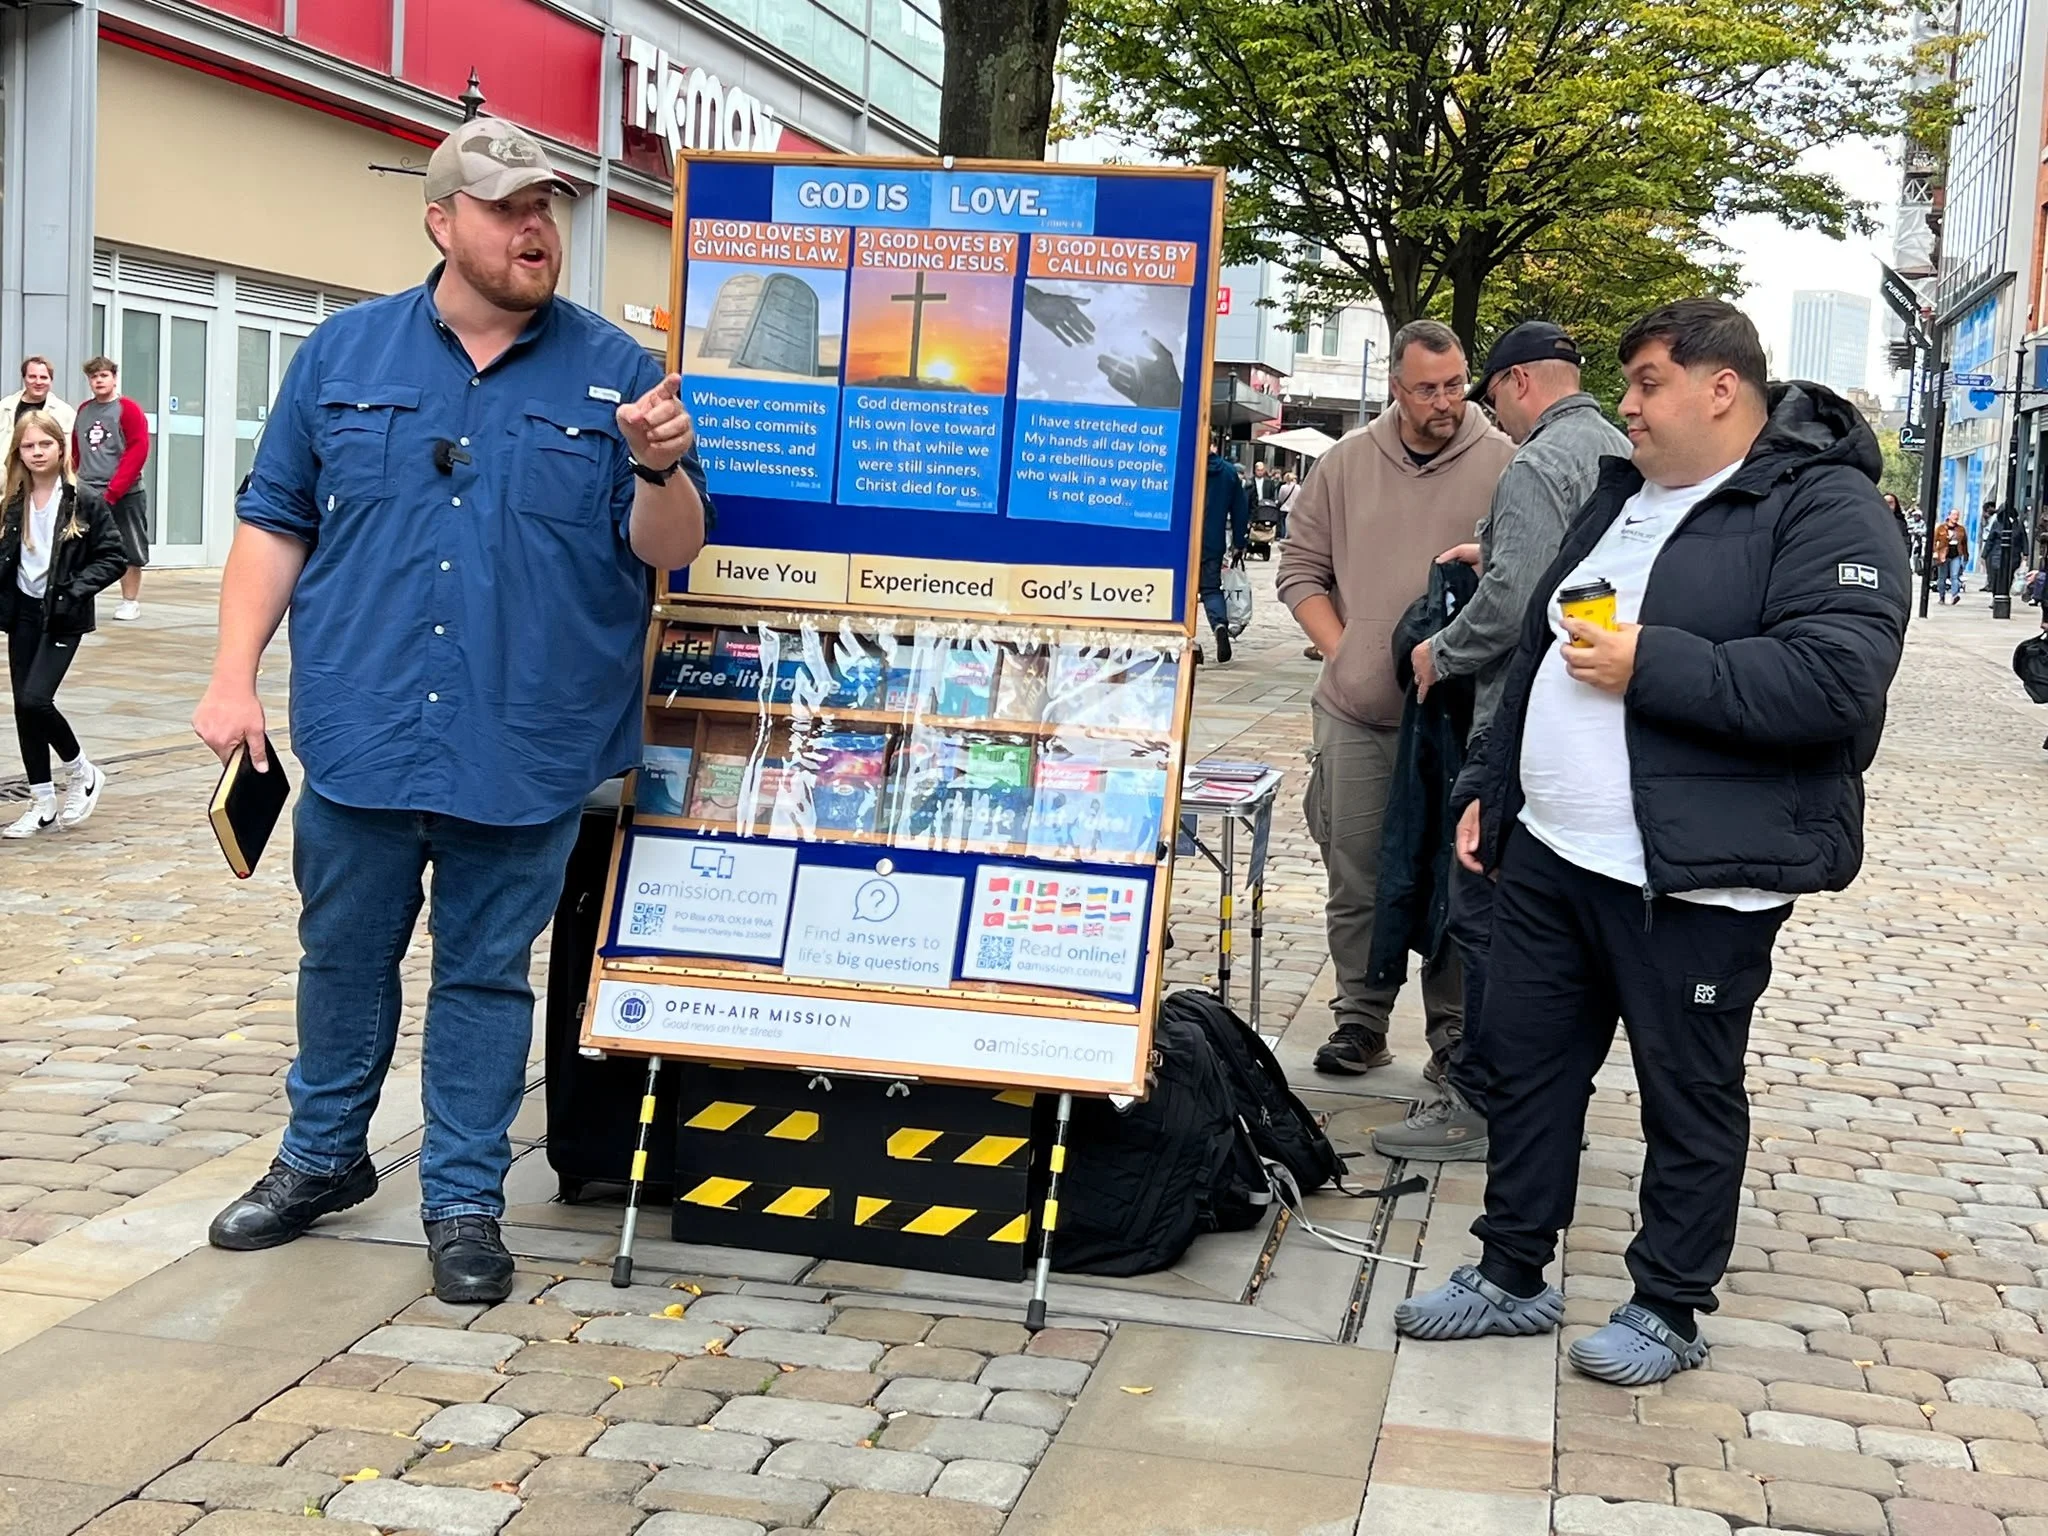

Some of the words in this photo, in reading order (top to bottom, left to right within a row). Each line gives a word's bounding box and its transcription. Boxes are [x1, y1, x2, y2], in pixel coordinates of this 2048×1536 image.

[799, 181, 870, 210] GOD
[876, 184, 909, 211] IS
[950, 185, 1048, 217] LOVE.
[693, 221, 708, 238] 1)
[712, 223, 751, 239] GOD
[755, 225, 816, 243] LOVES
[820, 227, 846, 244] BY
[859, 232, 875, 250] 2)
[879, 233, 919, 249] GOD
[923, 235, 985, 252] LOVES
[989, 237, 1014, 253] BY
[694, 240, 757, 257] GIVING
[761, 244, 790, 260] HIS
[795, 245, 843, 264] LAW.
[862, 251, 944, 269] SENDING
[949, 254, 1009, 272] JESUS.
[1037, 239, 1053, 256] 3)
[1057, 240, 1096, 256] GOD
[1101, 242, 1161, 260] LOVES
[1165, 246, 1191, 262] BY
[1048, 257, 1128, 277] CALLING
[1132, 263, 1176, 279] YOU!
[692, 391, 760, 409] Whoever
[763, 400, 826, 415] commits
[857, 396, 886, 410] God
[891, 397, 989, 415] demonstrates
[697, 414, 718, 427] sin
[722, 415, 751, 430] also
[755, 421, 817, 435] commits
[848, 415, 871, 429] His
[875, 421, 905, 432] own
[910, 419, 940, 433] love
[944, 423, 996, 436] toward
[1039, 415, 1071, 429] have
[1074, 418, 1137, 434] stretched
[1140, 424, 1164, 436] out
[696, 434, 784, 455] lawlessness,
[788, 443, 816, 457] and
[852, 439, 871, 451] us,
[876, 438, 888, 450] in
[893, 439, 921, 453] that
[925, 441, 964, 455] while
[968, 446, 989, 457] we
[1024, 432, 1046, 447] My
[1050, 434, 1088, 448] hands
[1092, 437, 1107, 450] all
[1111, 439, 1134, 454] day
[1138, 440, 1168, 457] long
[698, 455, 710, 469] in
[714, 456, 725, 470] is
[730, 457, 818, 478] lawlessness.
[858, 460, 894, 472] were
[897, 460, 922, 474] still
[926, 462, 980, 478] sinners,
[1021, 450, 1035, 462] to
[1038, 454, 1046, 463] a
[1050, 451, 1114, 468] rebellious
[1117, 459, 1166, 474] people,
[855, 477, 897, 492] Christ
[901, 479, 932, 494] died
[936, 482, 957, 496] for
[960, 486, 980, 497] us.
[1016, 469, 1045, 481] who
[1049, 470, 1079, 484] walk
[1083, 472, 1095, 485] in
[1099, 477, 1106, 486] a
[1110, 477, 1137, 490] way
[1141, 478, 1168, 491] that
[1049, 488, 1058, 500] is
[1062, 490, 1084, 503] not
[716, 560, 769, 581] Have
[776, 563, 816, 584] You
[860, 569, 994, 597] Experienced
[1021, 579, 1083, 600] God’s
[1090, 581, 1154, 603] Love?
[677, 664, 727, 686] Free
[638, 881, 778, 905] oamission.com
[804, 925, 841, 942] Find
[846, 932, 916, 948] answers
[923, 937, 941, 950] to
[837, 952, 861, 969] big
[864, 956, 940, 973] questions
[1020, 939, 1062, 958] Read
[1067, 947, 1127, 965] online!
[665, 1000, 760, 1020] OPEN-AIR
[769, 1008, 852, 1028] MISSION
[662, 1017, 689, 1031] Good
[690, 1021, 715, 1033] news
[717, 1025, 728, 1033] on
[729, 1024, 748, 1036] the
[749, 1026, 783, 1039] streets
[974, 1037, 1114, 1064] oamission.com
